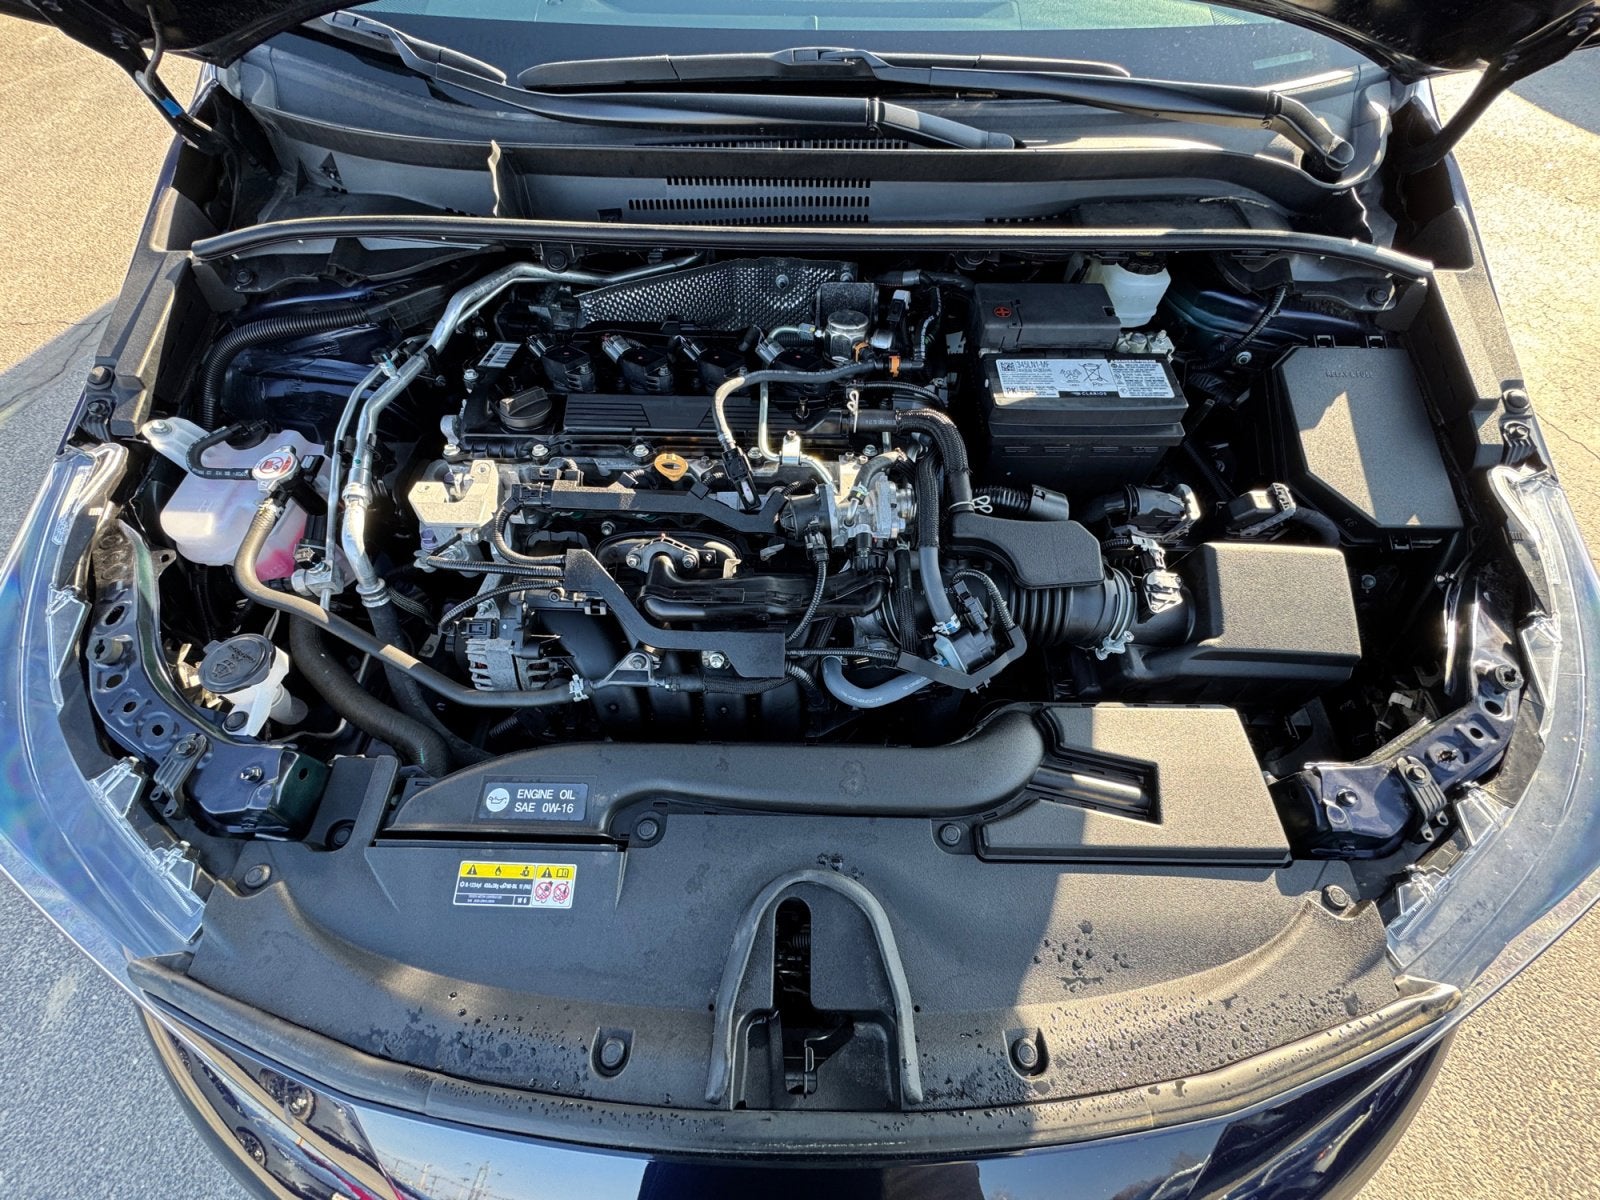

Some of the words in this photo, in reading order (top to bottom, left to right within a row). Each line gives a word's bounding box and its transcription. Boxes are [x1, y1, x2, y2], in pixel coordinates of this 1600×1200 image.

[517, 789, 554, 800] ENGINE
[559, 789, 575, 800] OIL
[514, 802, 536, 812] SAE
[542, 803, 574, 813] 0W-16
